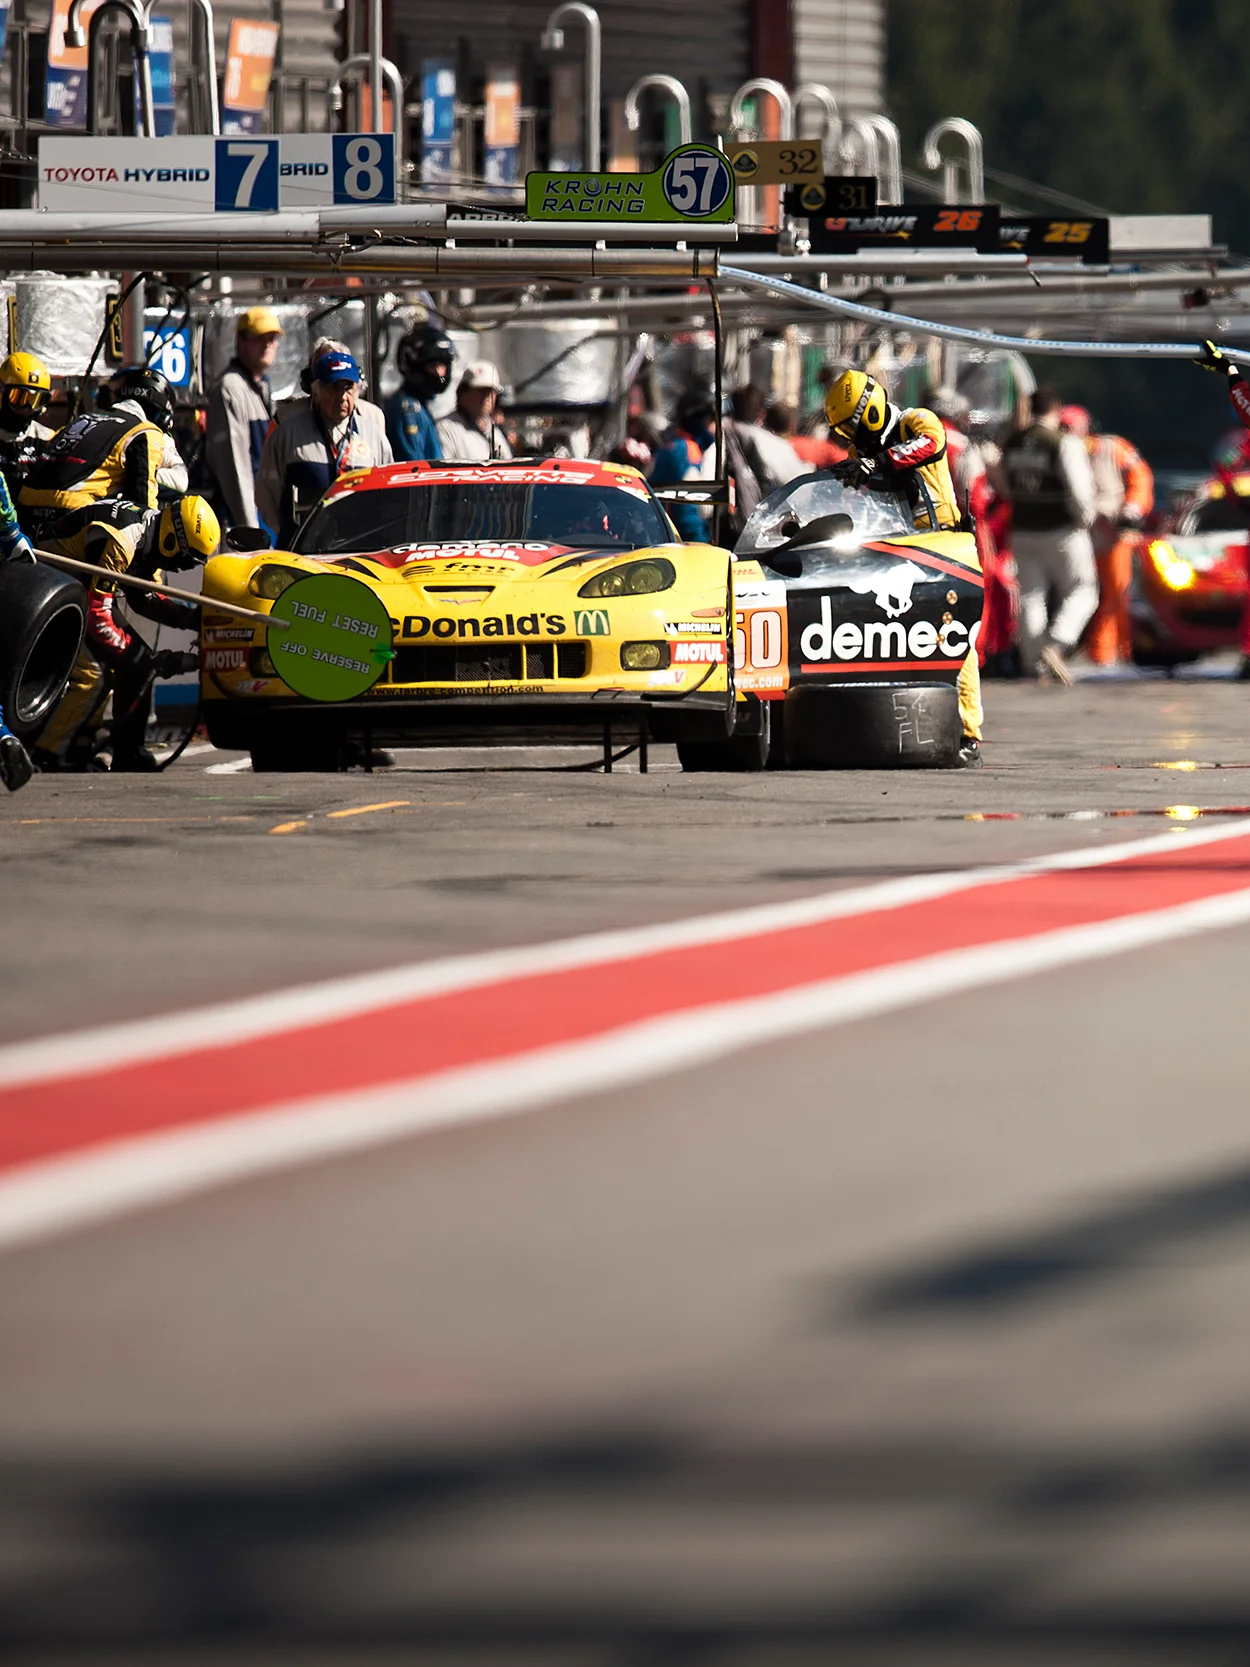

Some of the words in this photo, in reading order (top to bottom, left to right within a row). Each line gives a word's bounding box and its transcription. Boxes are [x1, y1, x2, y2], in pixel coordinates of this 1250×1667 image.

[344, 138, 383, 200] 8
[779, 149, 818, 175] 32
[43, 168, 119, 182] TOYOTA
[124, 168, 210, 182] HYBRID
[227, 143, 269, 208] 7
[671, 158, 719, 211] 57
[545, 178, 643, 197] KROHN
[541, 199, 645, 213] RACING
[839, 185, 870, 210] 31
[933, 211, 982, 231] 26
[1044, 223, 1091, 242] 25
[121, 385, 149, 398] uvex
[851, 388, 872, 424] uvex
[387, 469, 595, 486] CORVETTE
[452, 475, 588, 485] RACING
[405, 547, 520, 562] MOTUL
[291, 601, 327, 623] FUEL
[215, 629, 254, 639] MICHELIN
[332, 614, 379, 638] RESET
[677, 623, 721, 633] MICHELIN
[281, 641, 307, 656] OFF
[675, 643, 725, 662] MOTUL
[205, 650, 247, 669] MOTUL
[312, 649, 370, 674] RESERVE
[898, 719, 934, 754] FL
